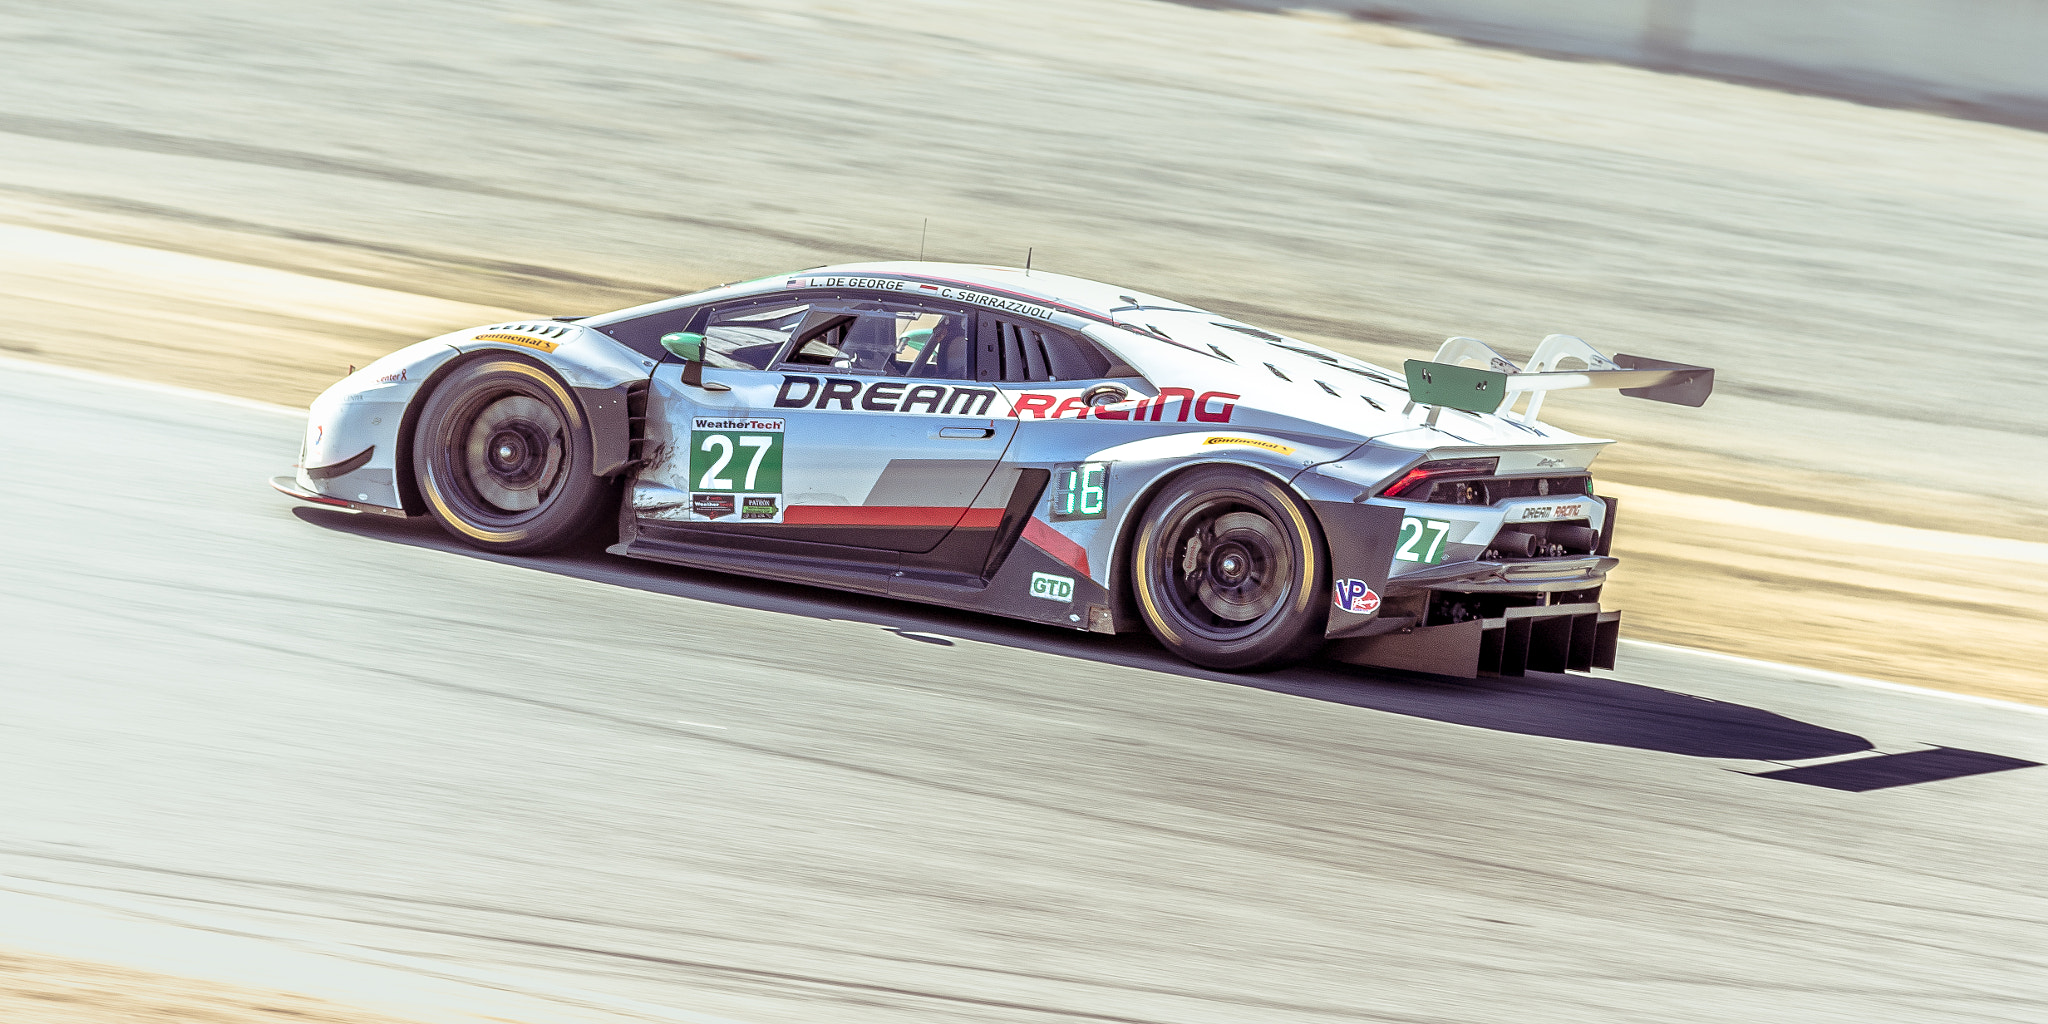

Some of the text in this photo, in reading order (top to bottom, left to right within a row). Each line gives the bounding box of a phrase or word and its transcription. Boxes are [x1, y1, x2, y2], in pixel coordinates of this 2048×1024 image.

[810, 277, 905, 291] L. DE GEORGE
[941, 288, 1054, 320] C. SBIRRAZZUOLI
[773, 374, 998, 415] DREAM
[695, 420, 781, 430] WeatherTech
[1207, 437, 1279, 449] Continental
[698, 434, 773, 490] 27
[1066, 462, 1104, 514] 16
[1522, 504, 1582, 519] DREAM RACING
[1395, 517, 1450, 563] 27
[1033, 577, 1072, 598] GTD
[1337, 580, 1367, 611] VP
